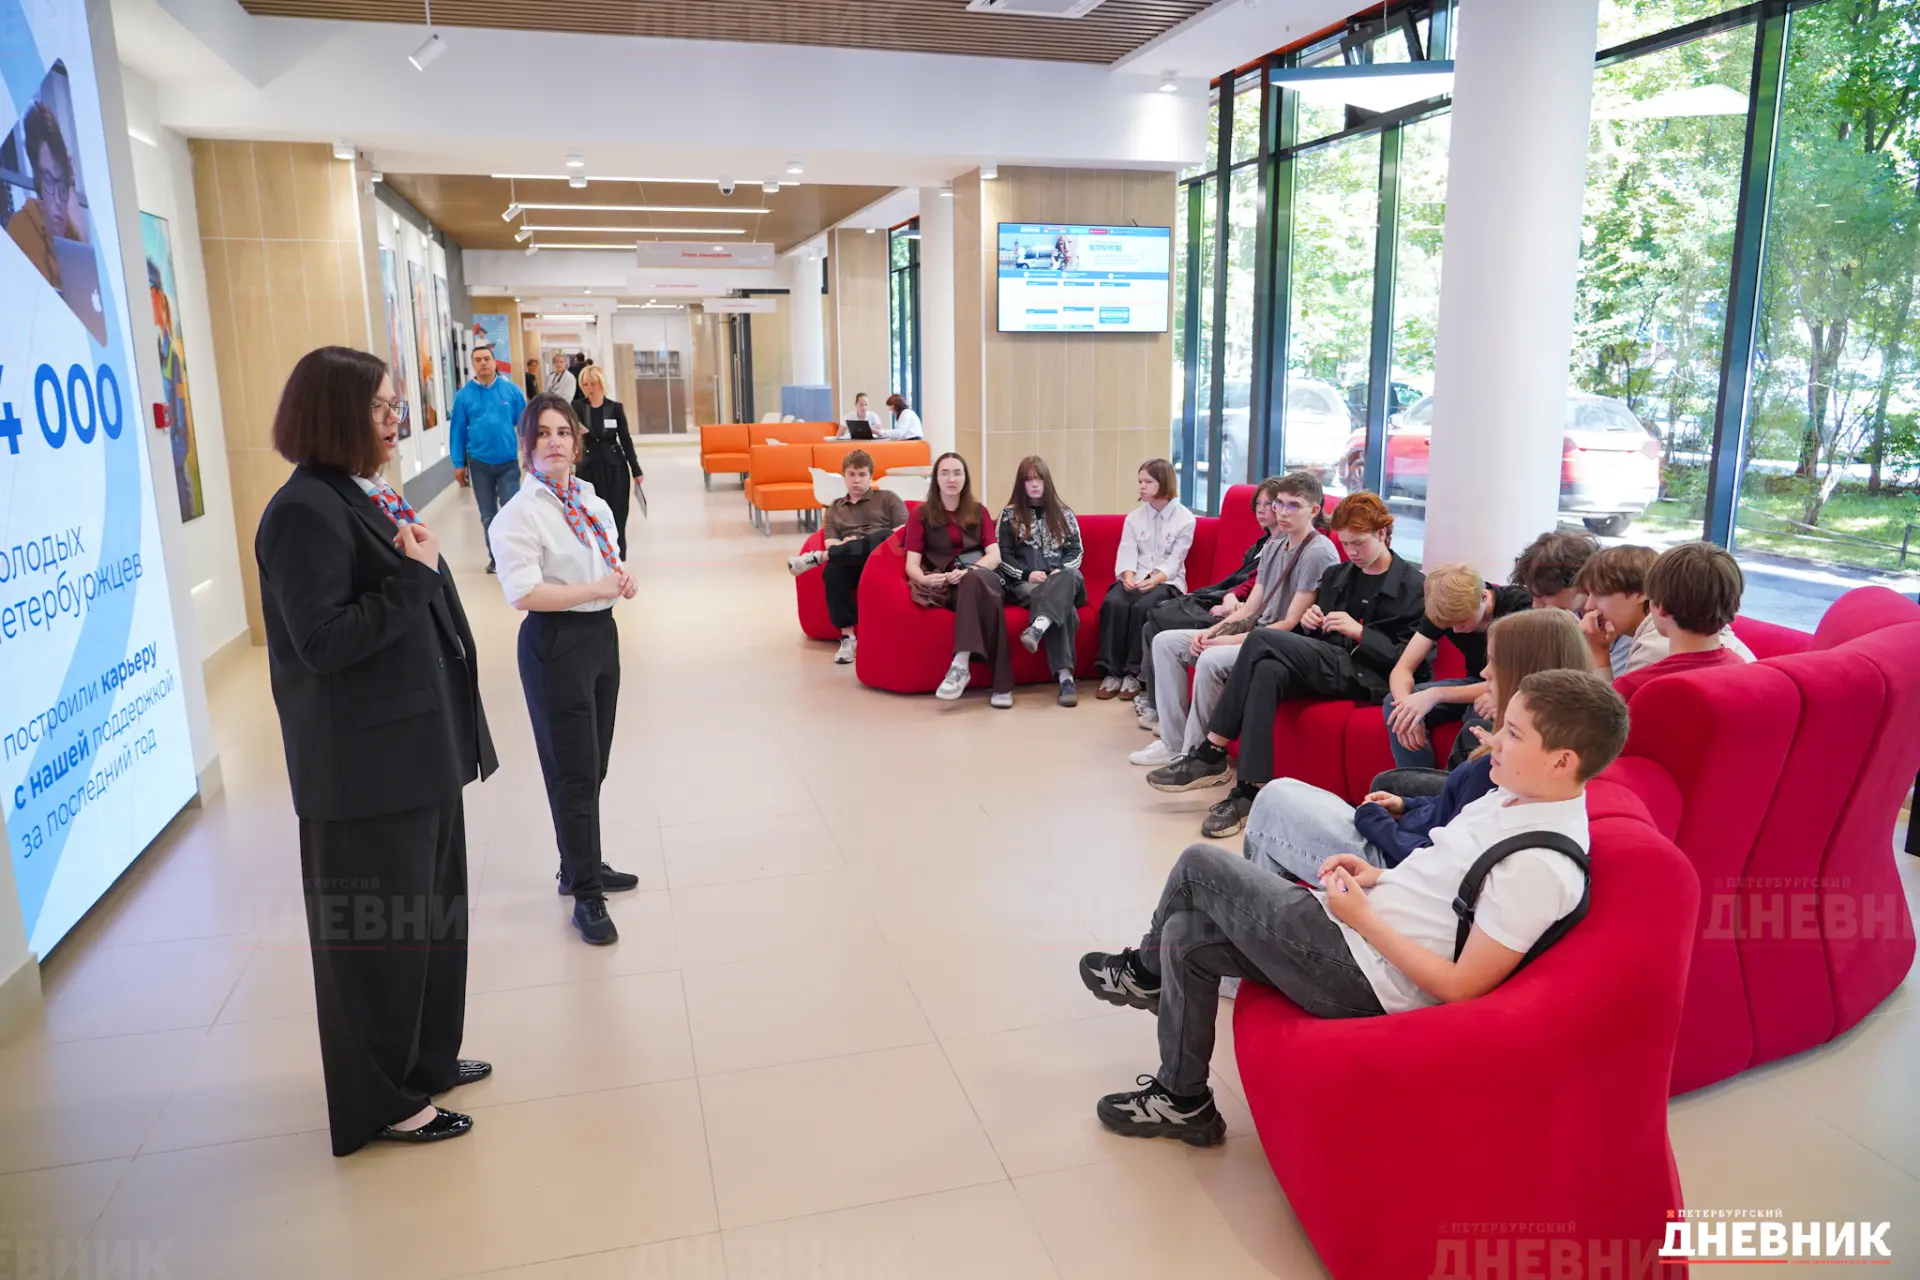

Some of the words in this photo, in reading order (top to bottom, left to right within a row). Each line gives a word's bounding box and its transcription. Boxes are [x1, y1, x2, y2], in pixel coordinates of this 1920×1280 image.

[34, 363, 123, 449] 000
[4, 680, 99, 762] построили
[101, 641, 157, 695] карьеру
[14, 784, 27, 810] с
[30, 730, 90, 799] нашей
[92, 668, 175, 750] поддержкой
[21, 825, 43, 858] за
[46, 743, 133, 837] последний
[135, 728, 158, 761] год
